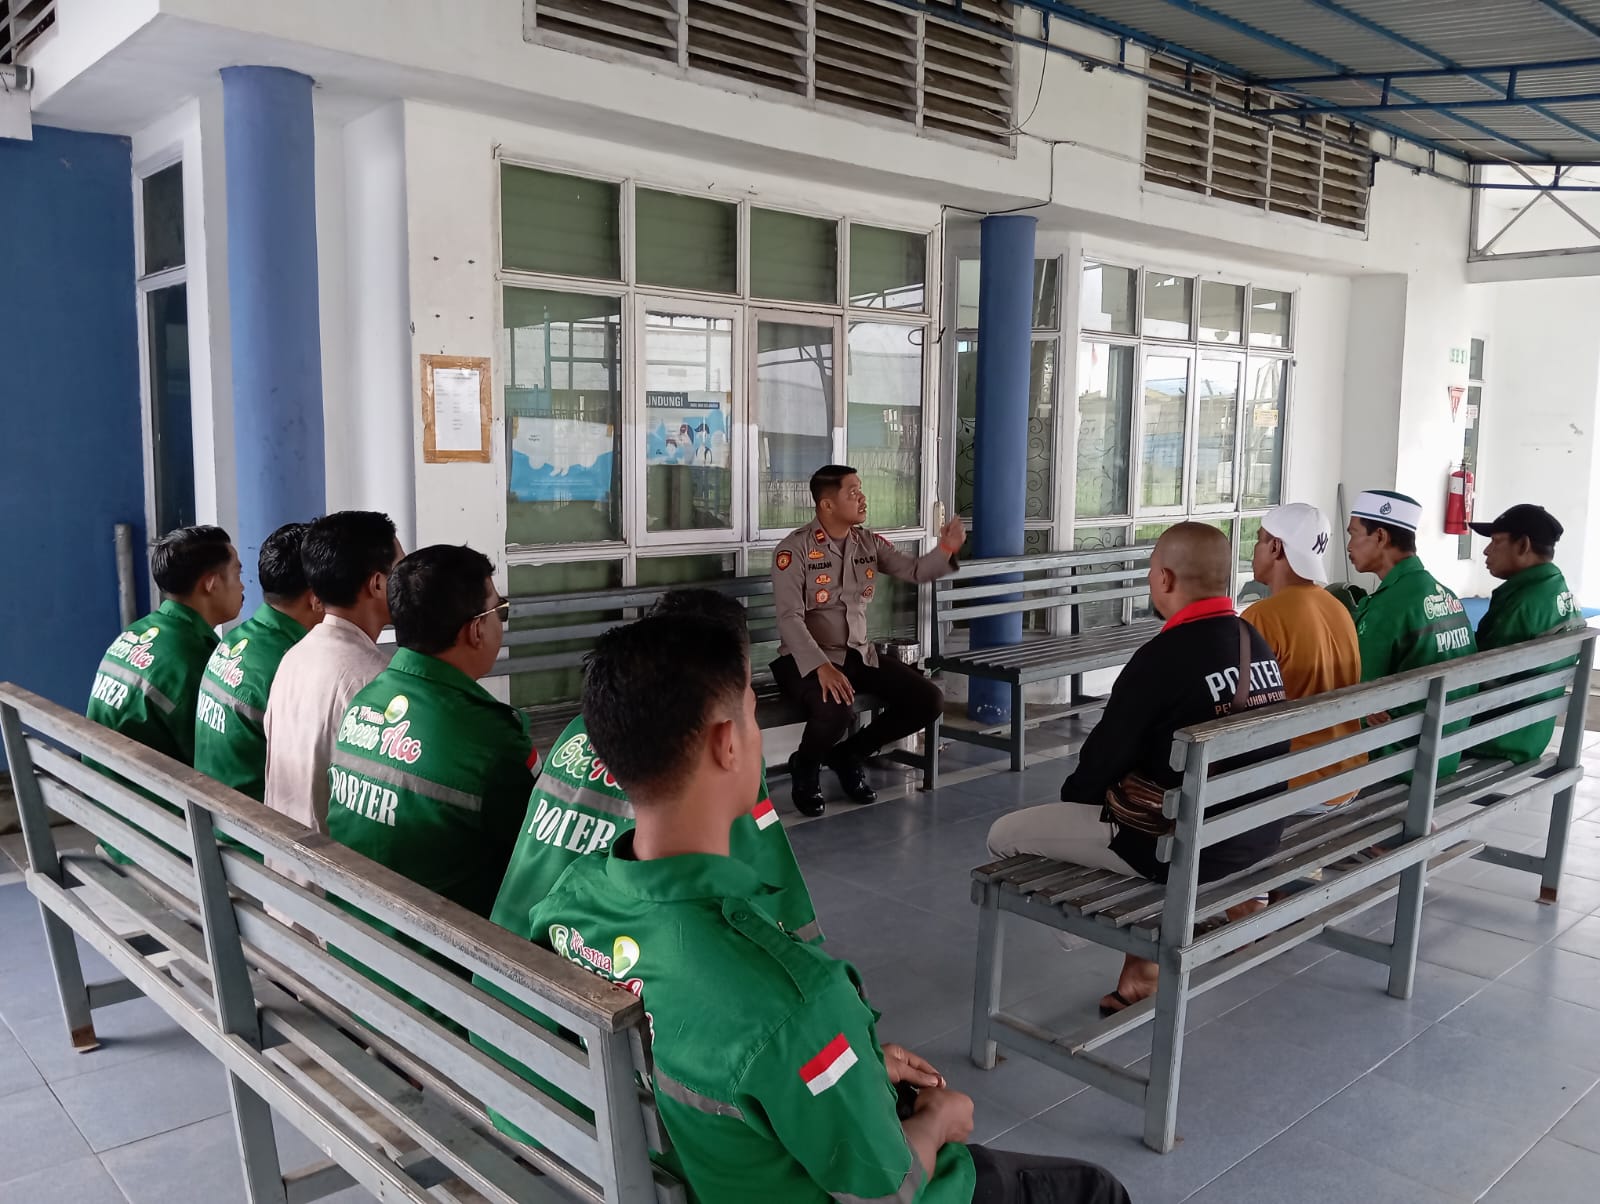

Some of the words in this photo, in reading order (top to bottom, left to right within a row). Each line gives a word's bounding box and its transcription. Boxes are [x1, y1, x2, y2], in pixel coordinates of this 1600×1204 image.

[646, 395, 683, 407] INDUNGI
[329, 766, 399, 827] PORTER
[570, 927, 612, 973] Wisma
